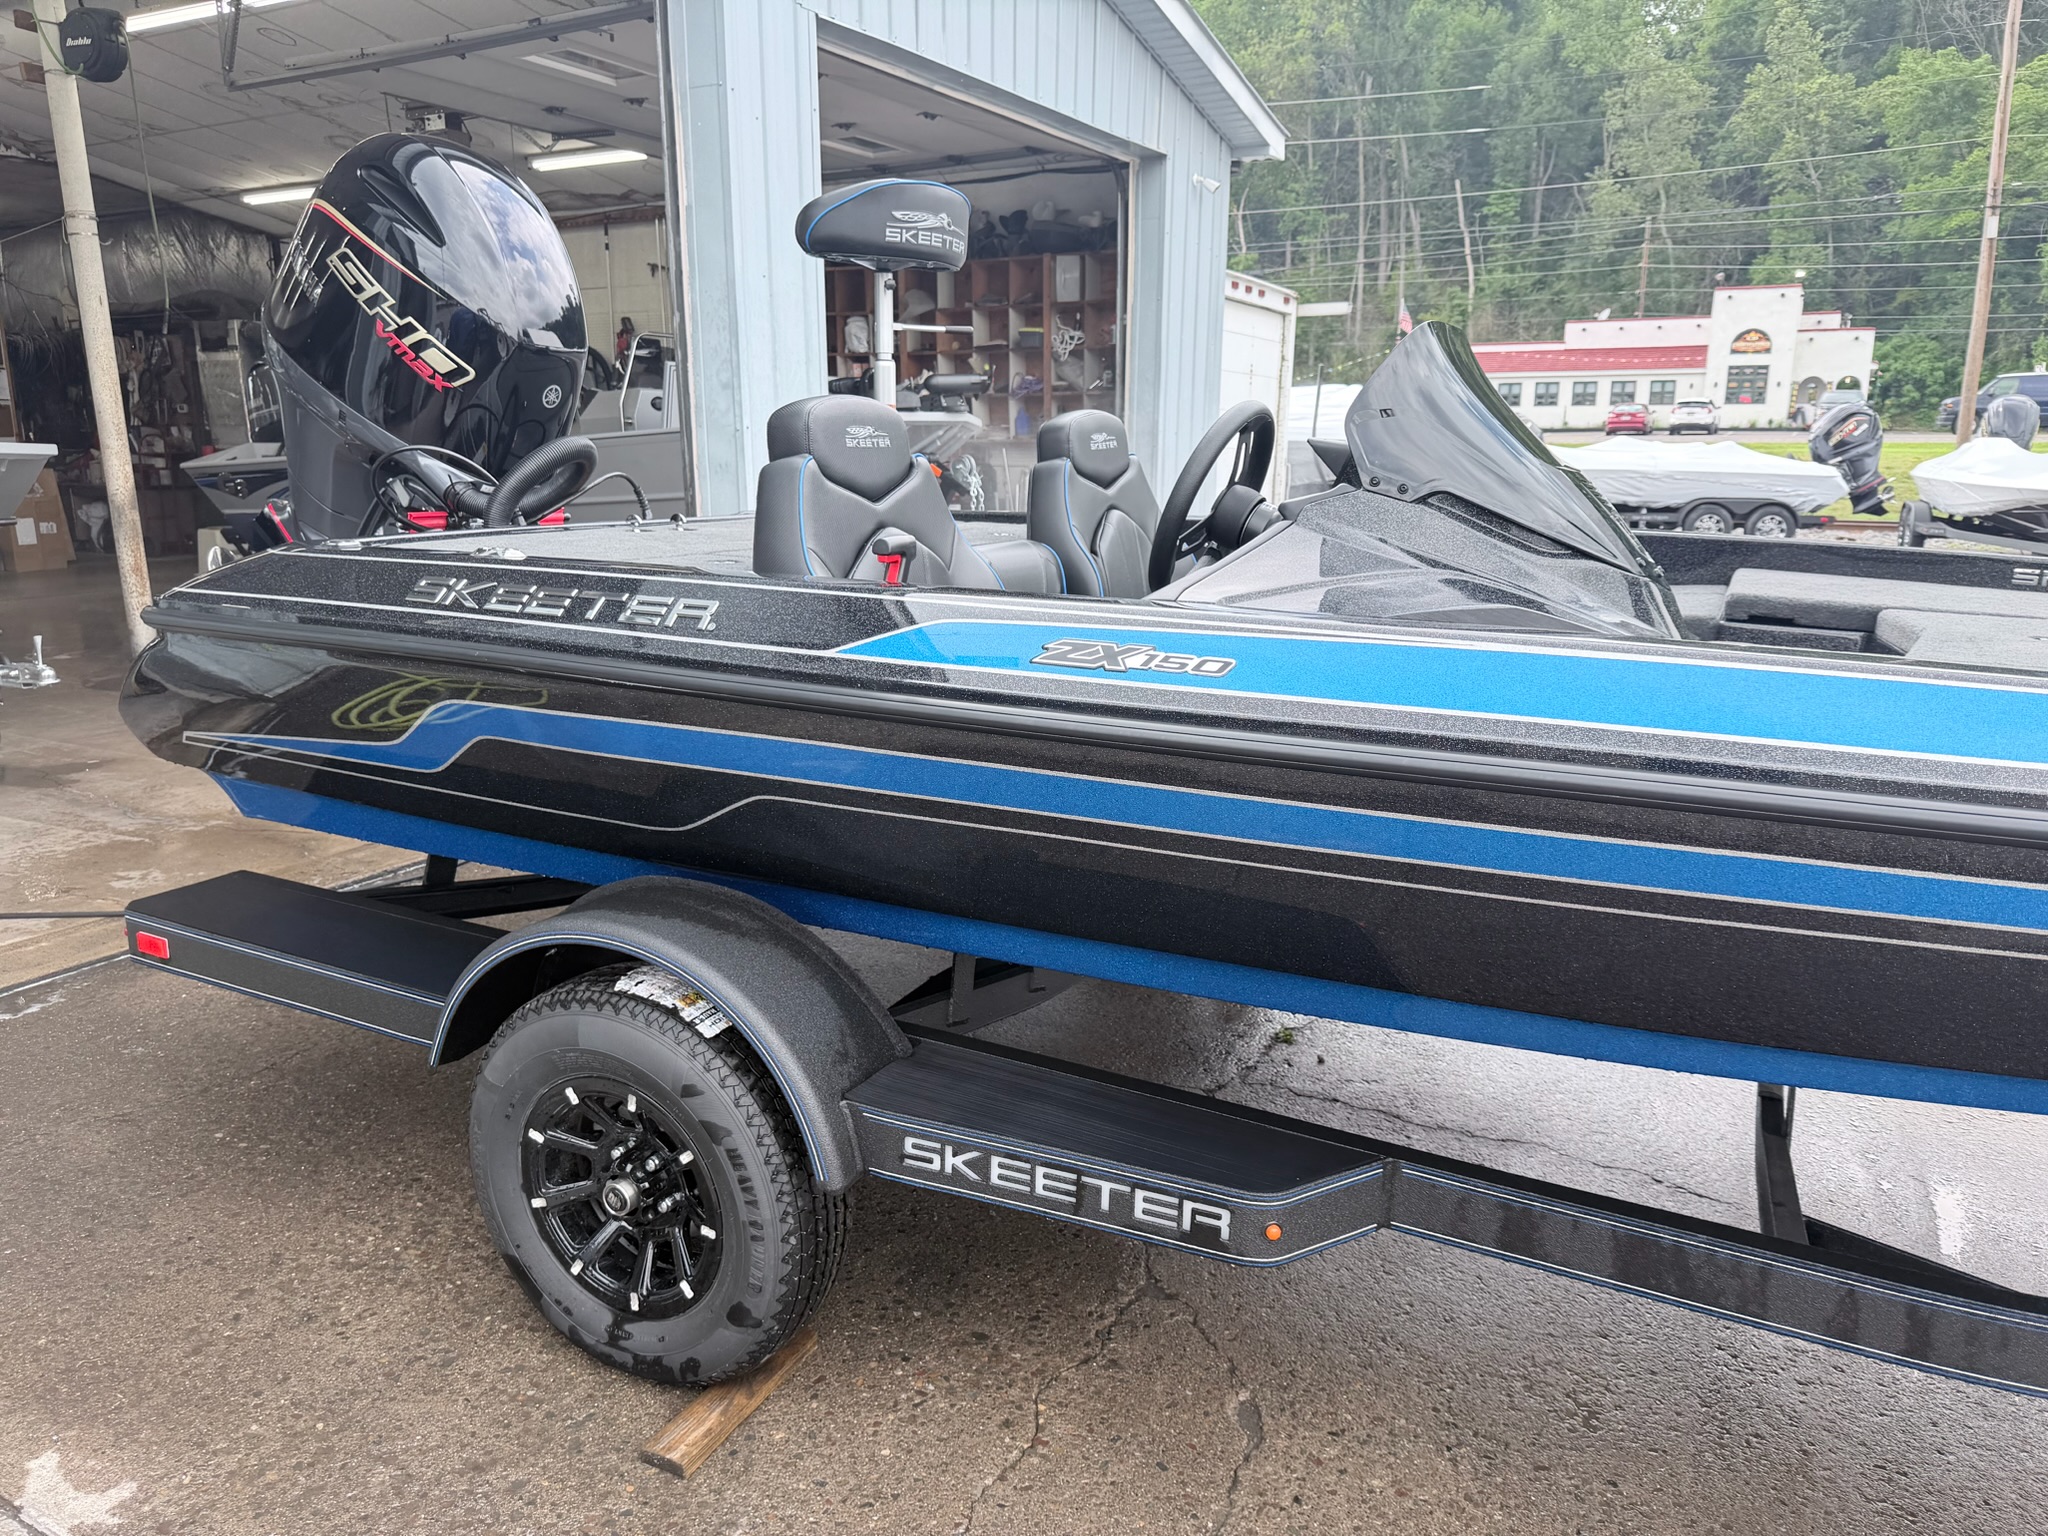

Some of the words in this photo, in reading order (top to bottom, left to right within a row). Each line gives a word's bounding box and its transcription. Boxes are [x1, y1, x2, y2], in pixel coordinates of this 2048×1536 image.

[885, 227, 965, 255] SKEETER
[845, 437, 892, 448] SKEETER
[405, 576, 719, 632] SKEETER
[903, 1135, 1232, 1242] SKEETER
